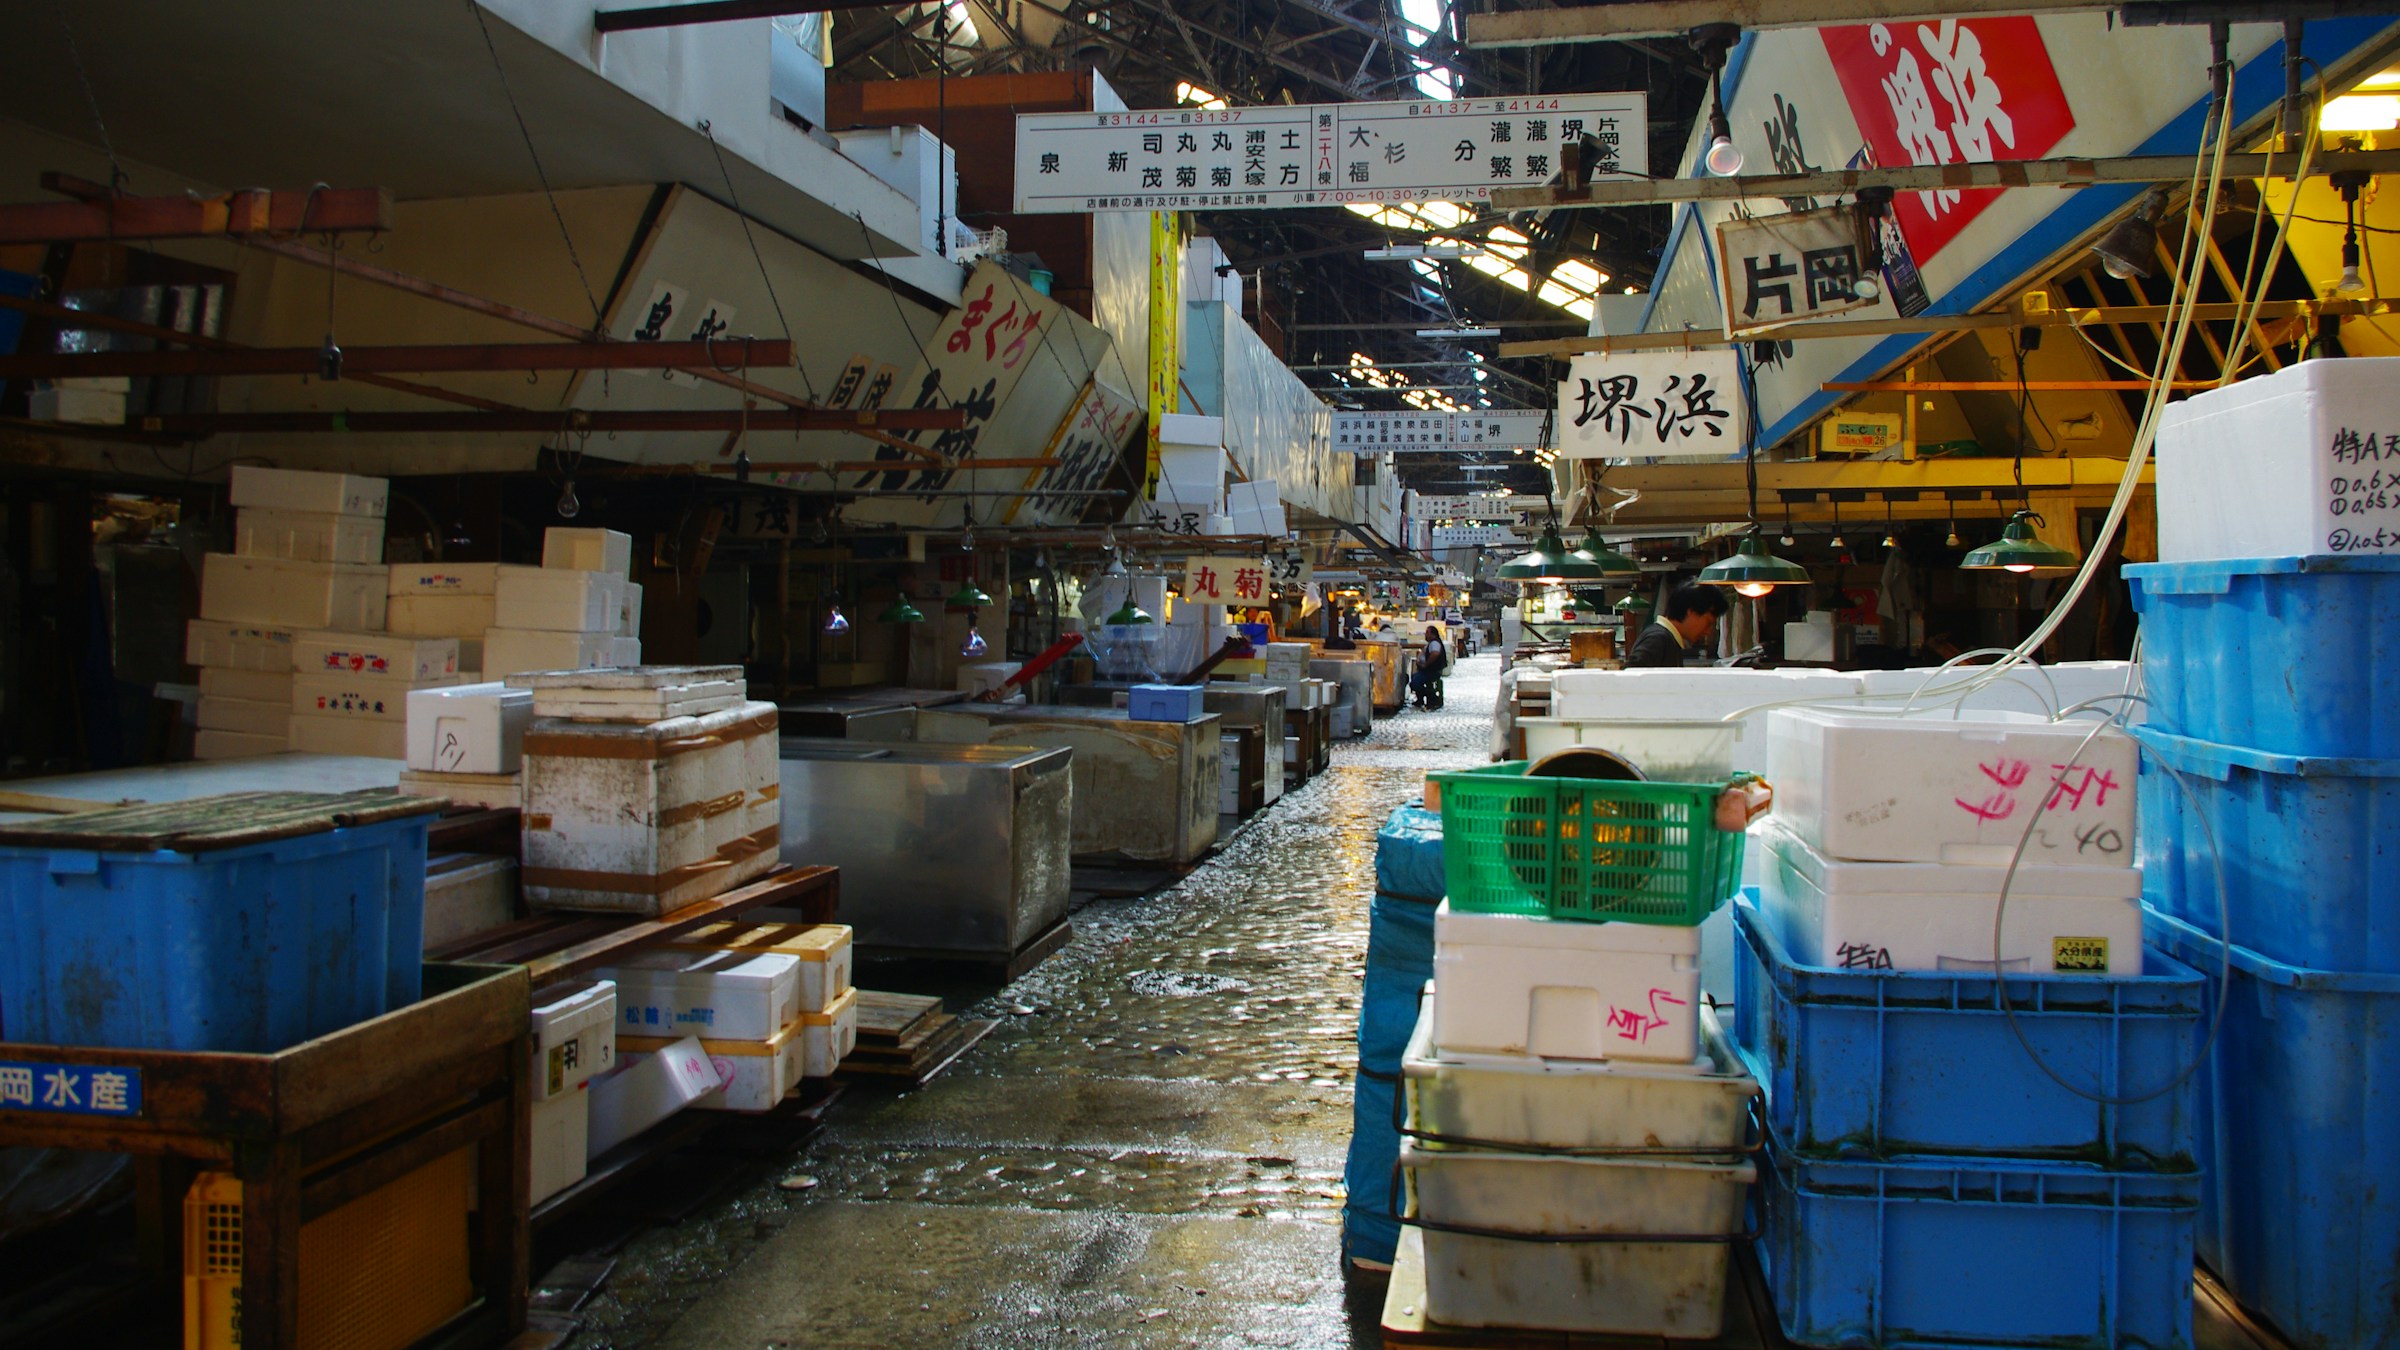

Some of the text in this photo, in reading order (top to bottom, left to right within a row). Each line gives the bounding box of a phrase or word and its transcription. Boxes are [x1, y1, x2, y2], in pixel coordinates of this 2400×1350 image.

[1040, 151, 1128, 174] 泉 新
[1142, 133, 1162, 189] 司茂
[1175, 131, 1197, 188] 丸菊
[1211, 131, 1232, 187] 丸菊
[1245, 129, 1266, 186] 浦安大塚
[1279, 129, 1301, 186] 土方
[1318, 114, 1332, 185] 第二十八棟
[1384, 139, 1476, 164] 杉 分
[1742, 244, 1862, 320] 片岡
[946, 283, 1043, 370] まぐろ
[1573, 372, 1731, 446] 堺浜
[1191, 566, 1264, 600] 丸菊
